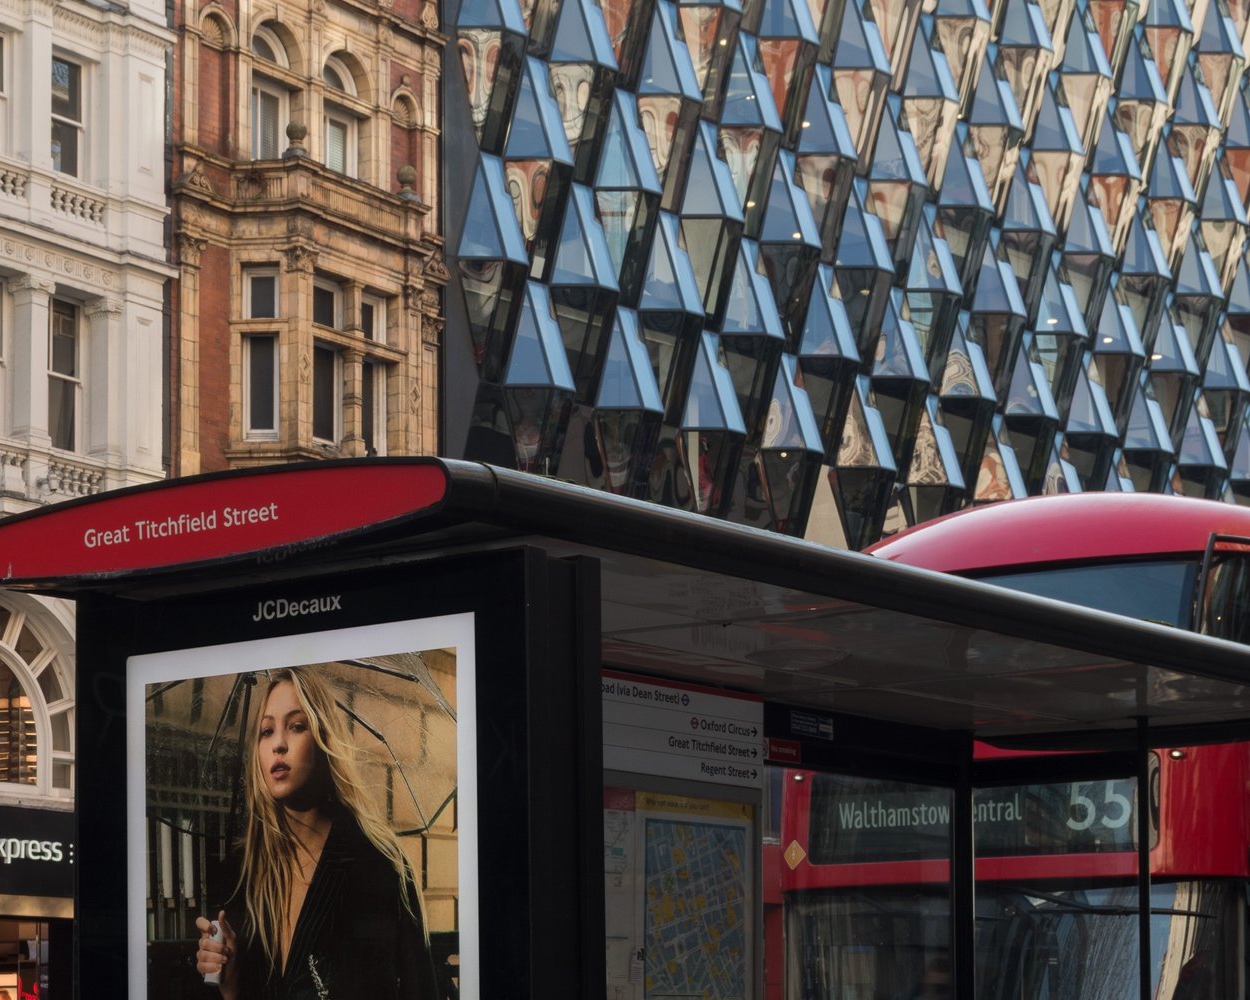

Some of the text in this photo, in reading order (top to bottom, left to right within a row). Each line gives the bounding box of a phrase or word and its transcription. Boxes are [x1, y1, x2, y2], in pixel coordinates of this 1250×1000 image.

[84, 501, 279, 549] Great Titchfield Street
[252, 594, 342, 622] JCDecaux
[601, 683, 615, 694] oad
[632, 686, 653, 701] Dean
[654, 689, 680, 705] Street)
[700, 718, 751, 737] Oxford Circus
[668, 736, 751, 758] Great Titchfield Street
[700, 762, 751, 779] Regent Street
[838, 793, 1022, 829] Walthamstow entral
[1066, 781, 1131, 831] 55
